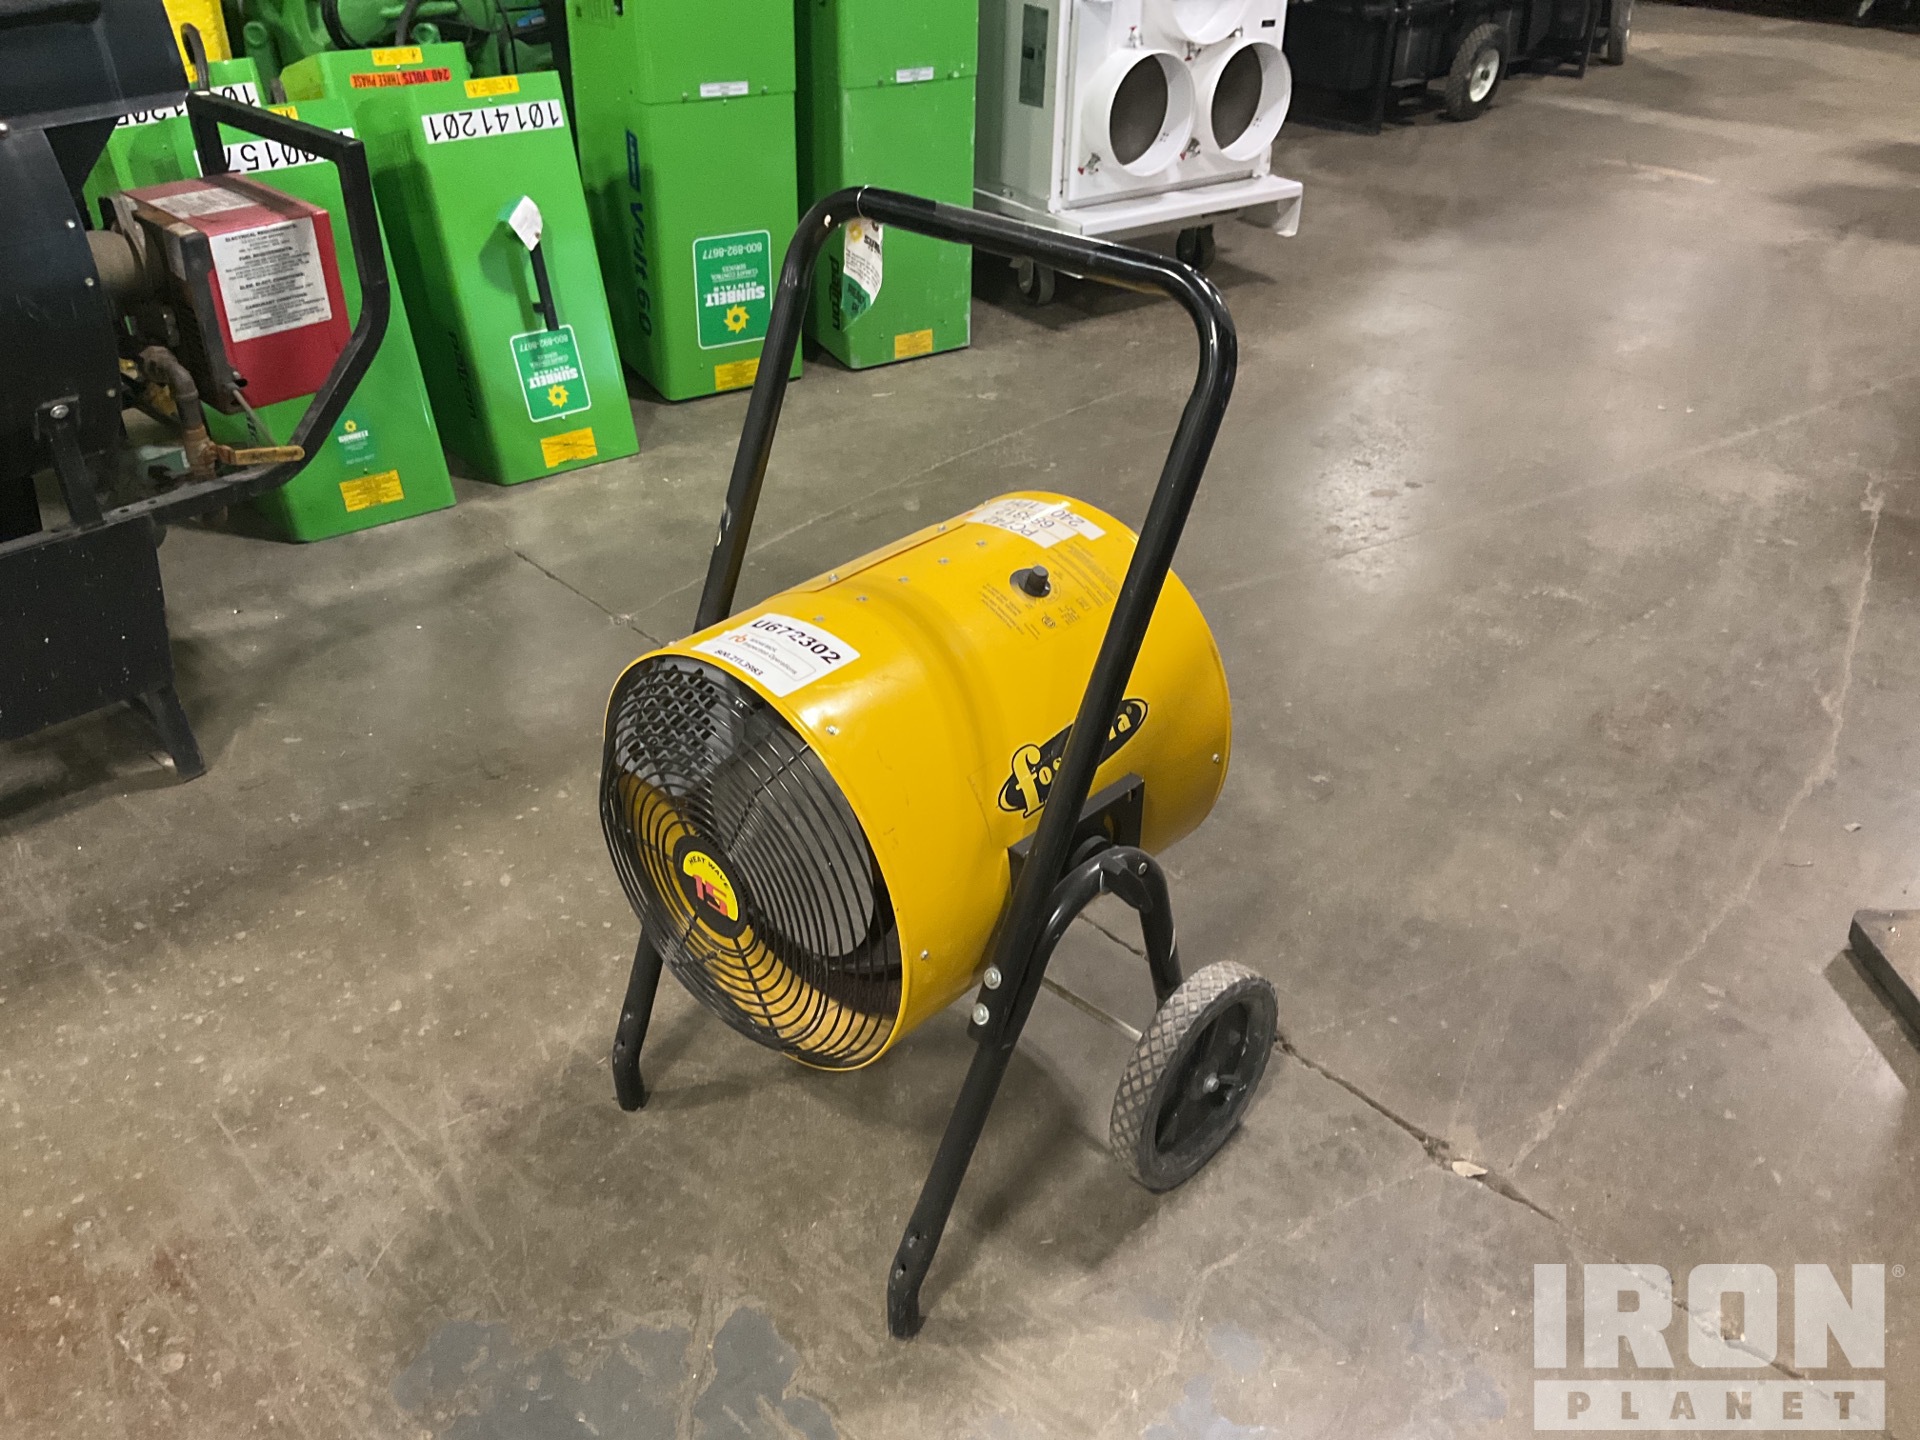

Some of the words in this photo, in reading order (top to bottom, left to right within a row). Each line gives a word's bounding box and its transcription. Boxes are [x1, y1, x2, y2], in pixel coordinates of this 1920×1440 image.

[377, 73, 401, 86] THREE
[403, 70, 428, 84] VOLTS
[432, 70, 450, 81] 240
[428, 102, 559, 142] 10141201
[705, 286, 766, 307] SUNBELT
[529, 367, 578, 389] SUNBELT
[752, 620, 841, 664] U672302
[688, 855, 706, 866] HEAT
[708, 862, 730, 888] WAVE
[693, 874, 728, 916] 15
